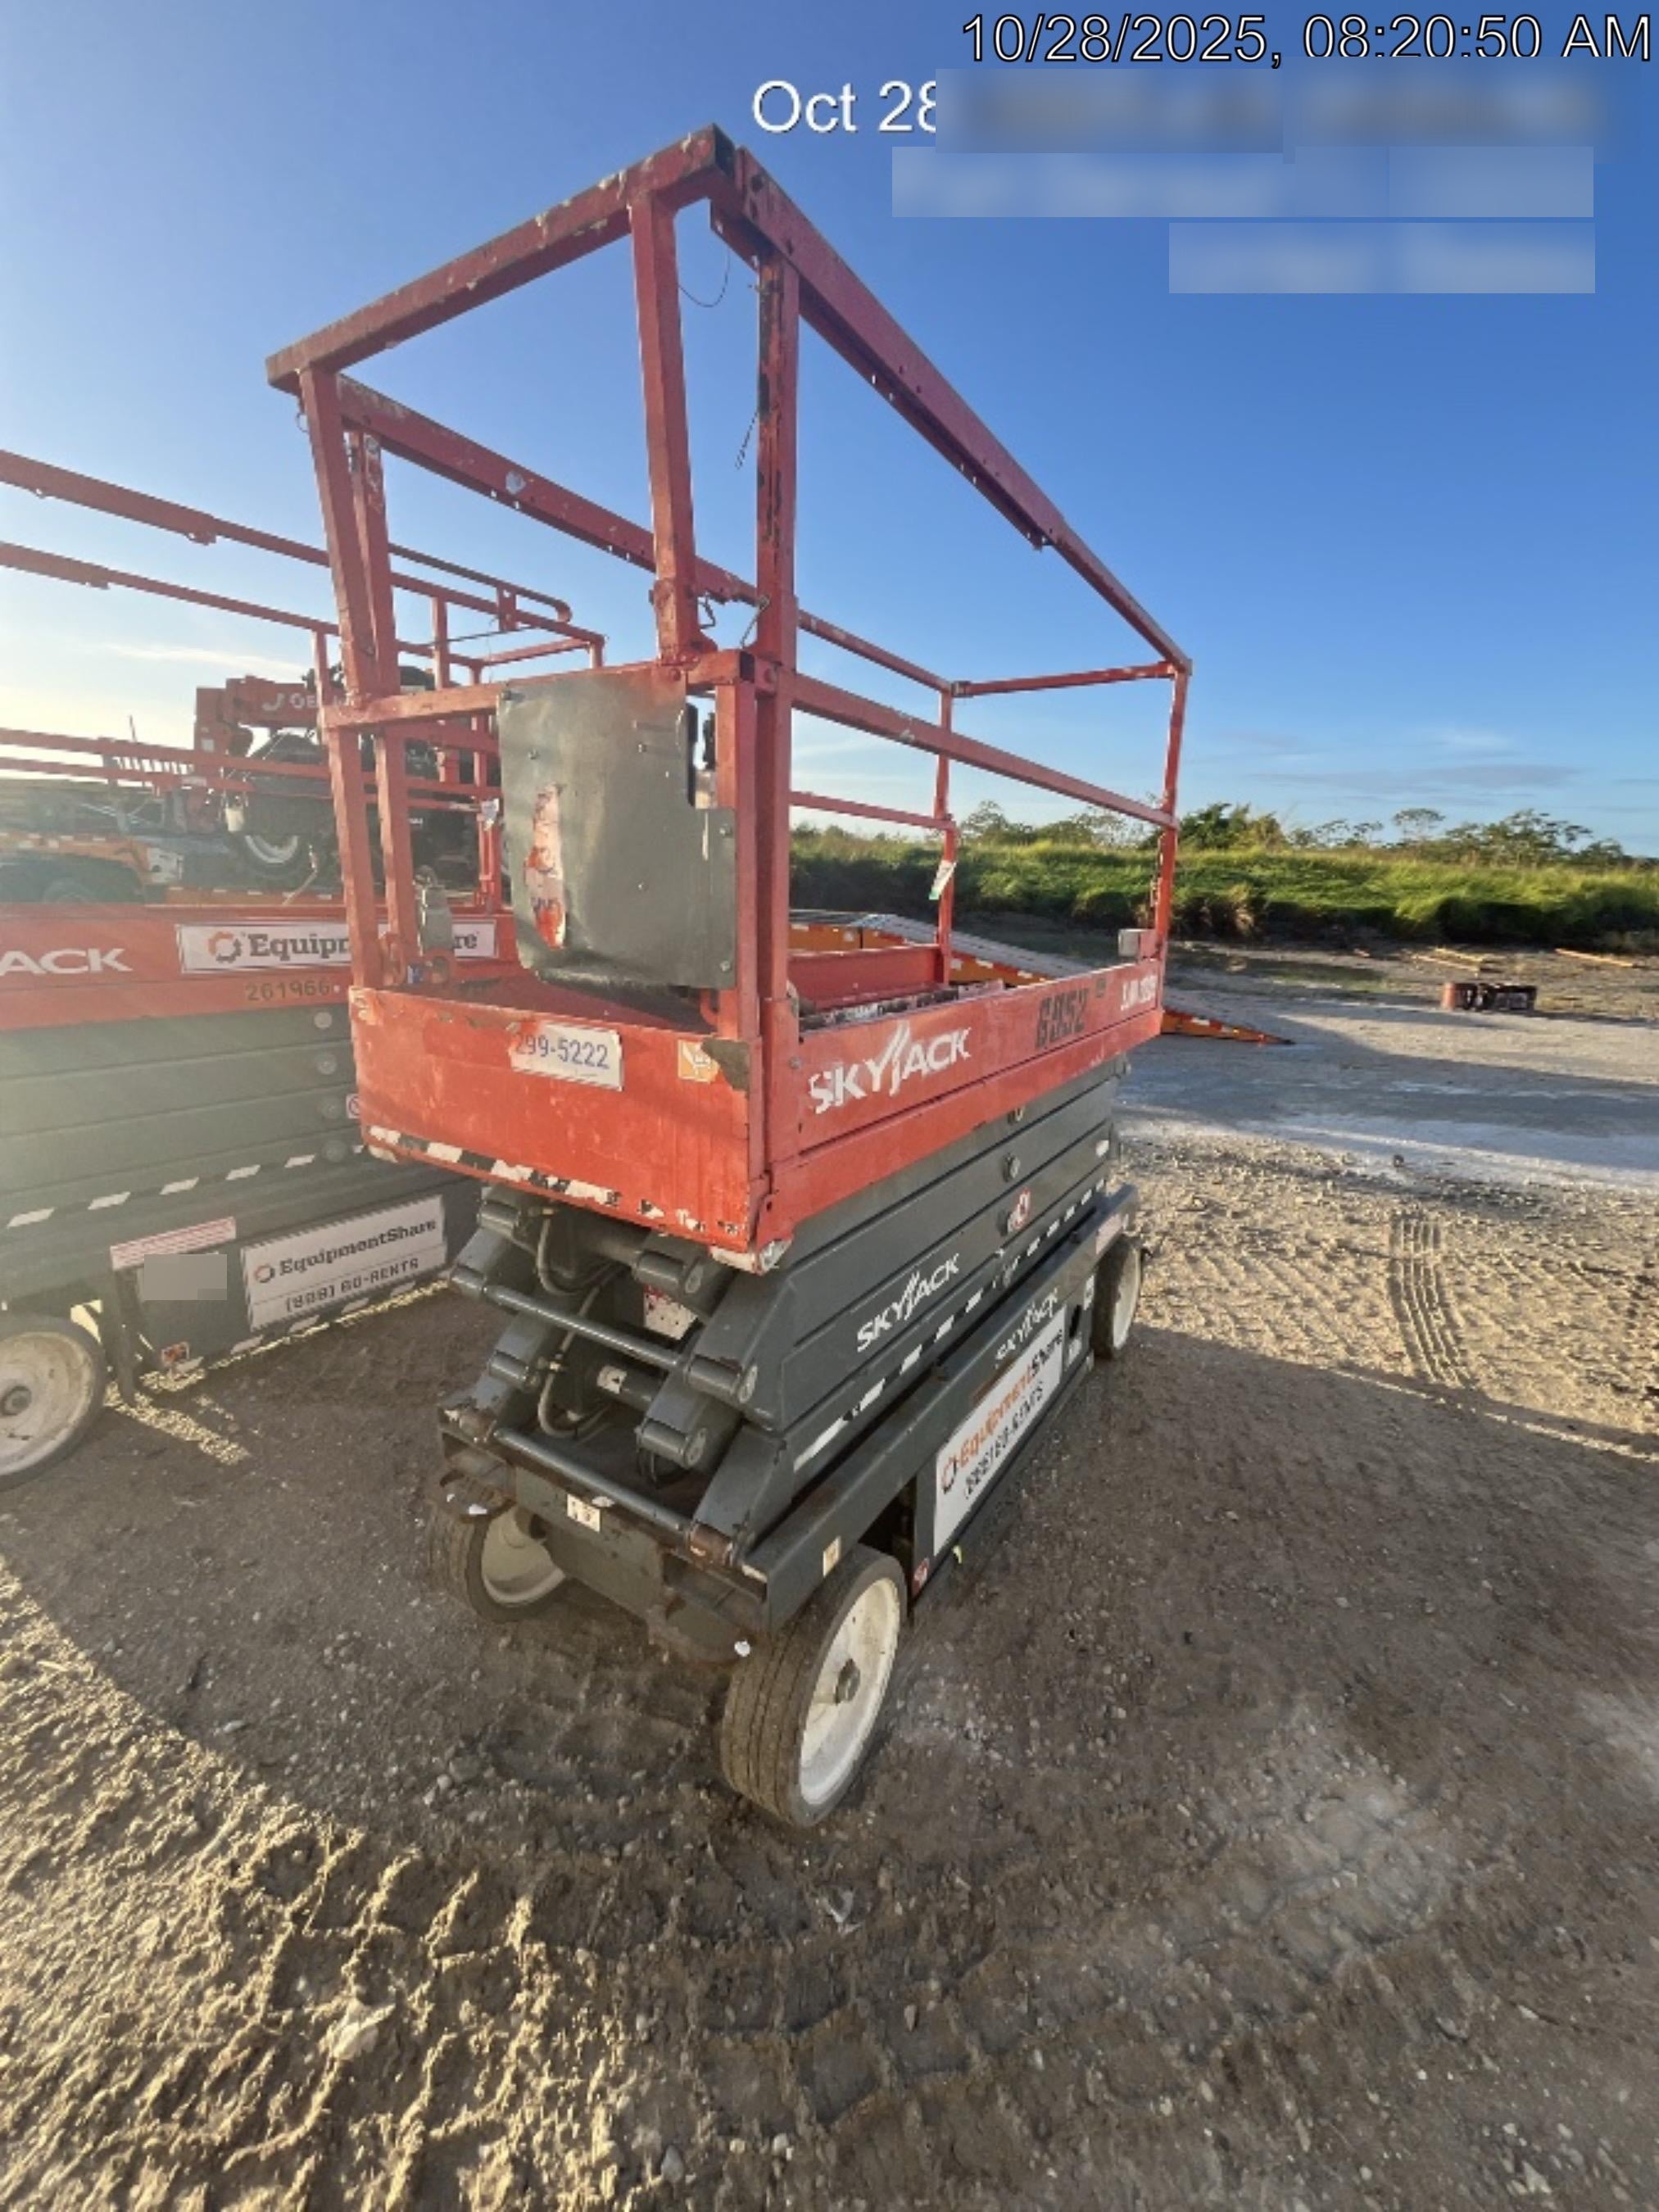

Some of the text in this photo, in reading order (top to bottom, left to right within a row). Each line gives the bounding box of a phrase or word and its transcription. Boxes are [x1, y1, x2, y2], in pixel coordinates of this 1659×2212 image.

[808, 1020, 972, 1115] SKYJACK
[279, 1218, 436, 1276] EquipmentShare
[857, 1252, 959, 1353] SKYJACK
